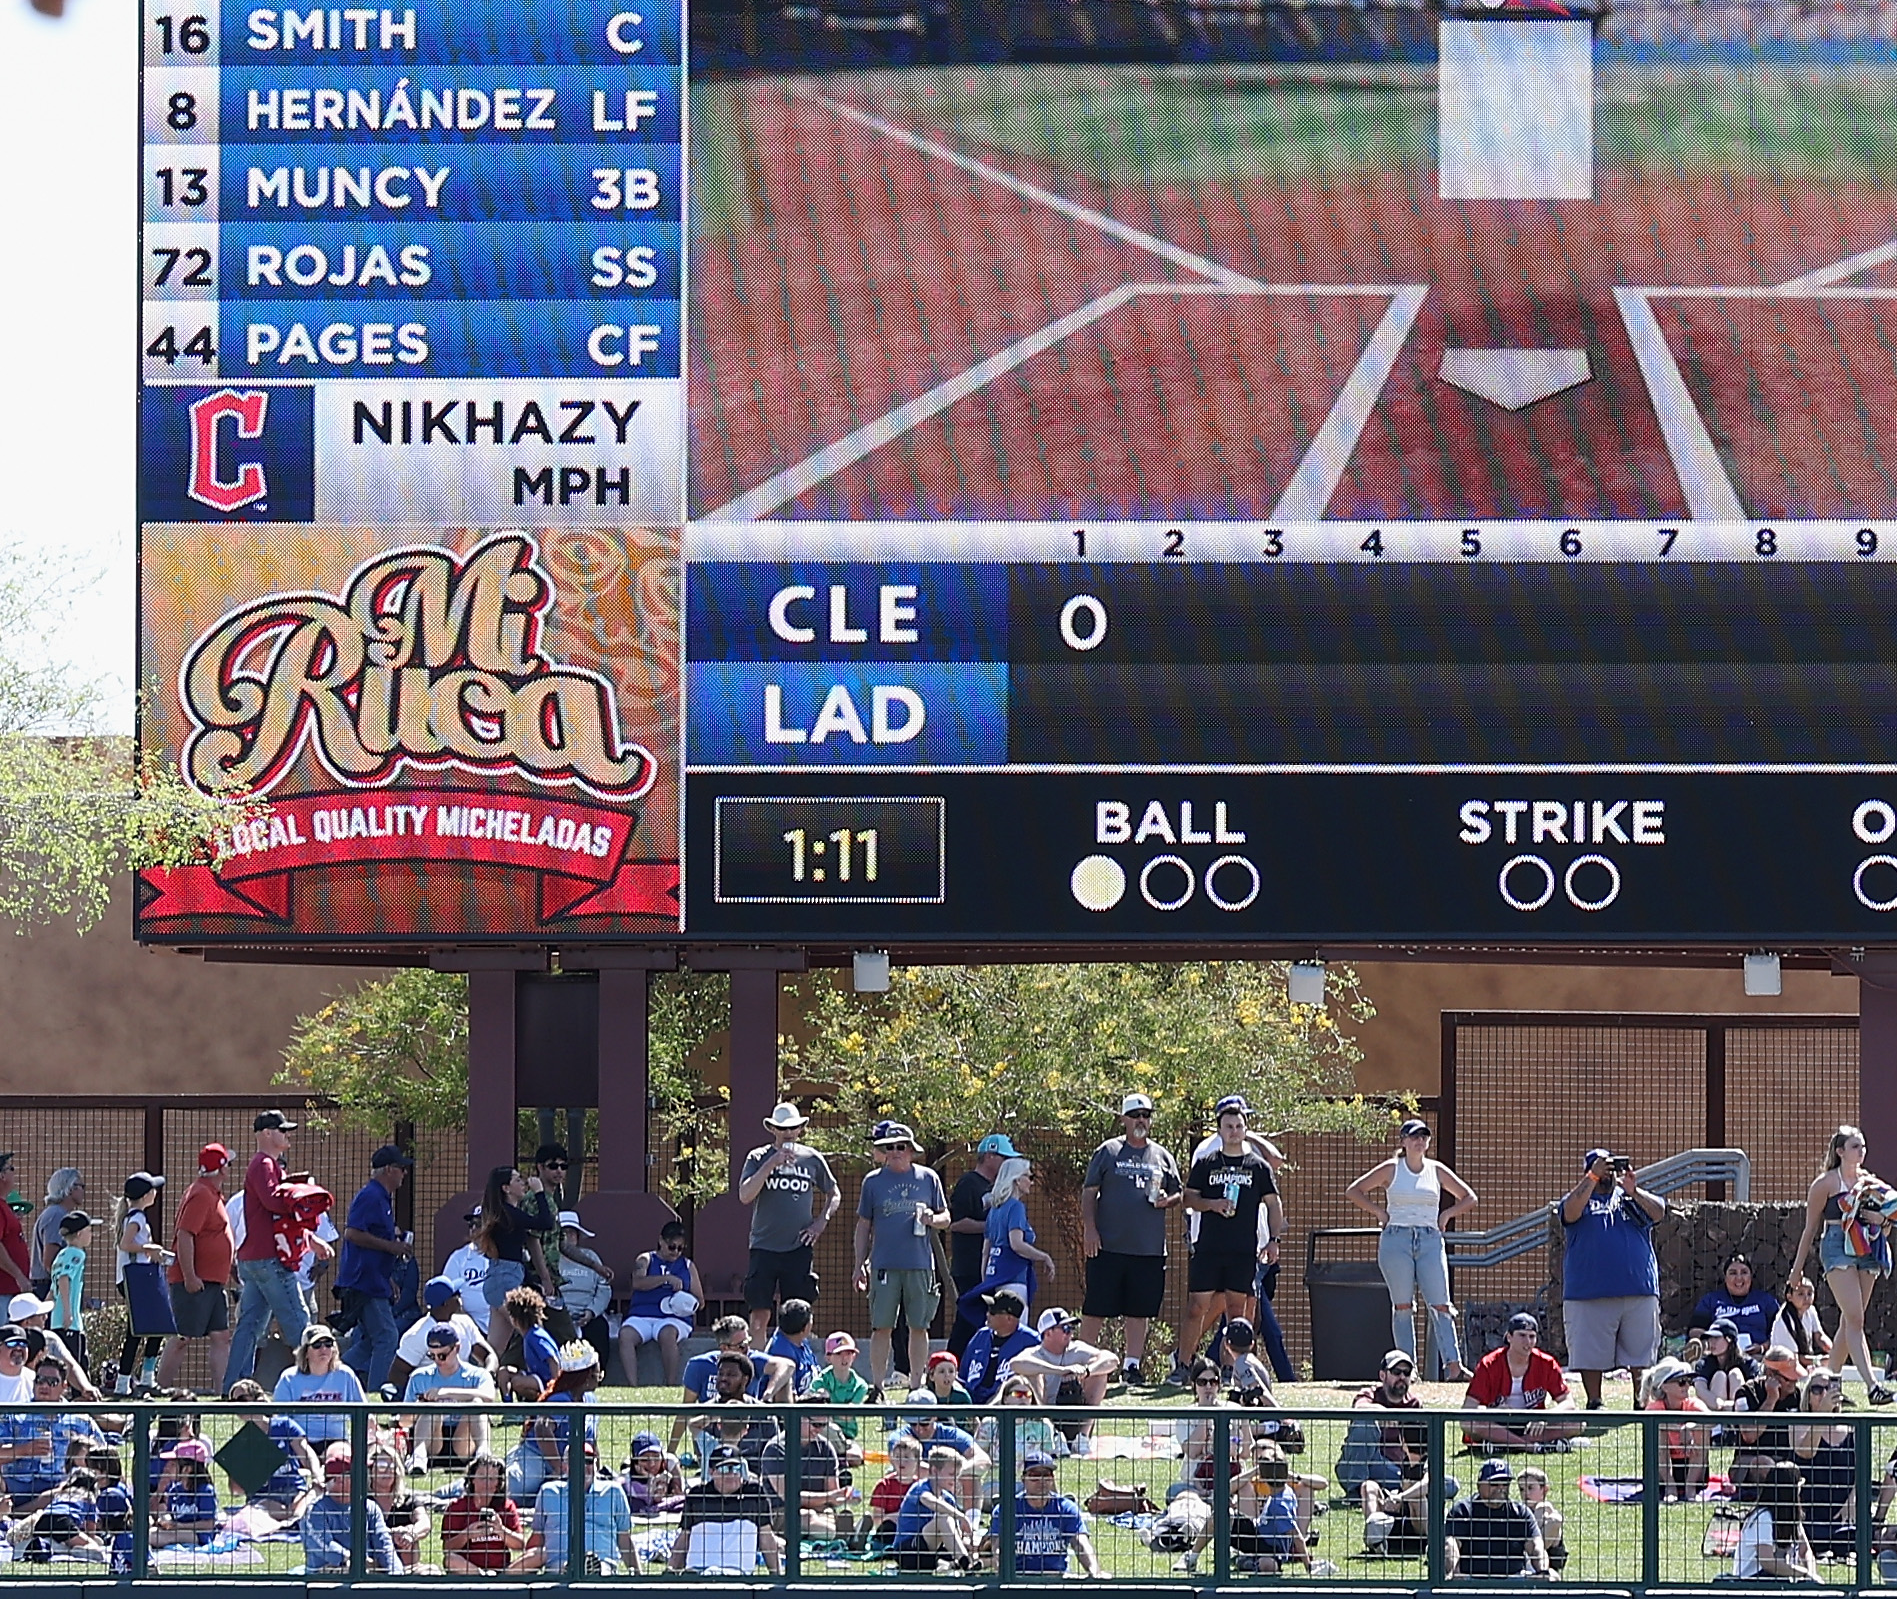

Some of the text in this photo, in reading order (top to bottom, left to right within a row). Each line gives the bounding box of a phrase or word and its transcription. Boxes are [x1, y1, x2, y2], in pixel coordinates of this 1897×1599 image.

[157, 9, 642, 55] 16 SMITH C
[167, 78, 657, 131] 8 HERNÁNDEZ LF
[157, 166, 659, 208] 13 MUNCY 3B
[154, 245, 656, 287] 72 ROJAS SS
[146, 323, 660, 365] 44 PAGES CF
[353, 401, 640, 444] NIKHAZY
[513, 467, 629, 506] MPH
[1073, 529, 1086, 557] 1
[1163, 529, 1184, 557] 2
[1264, 529, 1283, 557] 3
[1360, 529, 1384, 557] 4
[1461, 529, 1480, 557] 5
[1559, 529, 1581, 557] 6
[1658, 529, 1678, 557] 7
[1756, 529, 1777, 557] 8
[1856, 529, 1877, 557] 9
[344, 532, 555, 670] Mi
[769, 585, 917, 642] CLE
[1061, 595, 1107, 650] 0
[765, 685, 924, 742] LAD
[313, 804, 429, 843] QUALITY
[436, 805, 613, 857] MICHELADAS
[1097, 801, 1245, 843] BALL
[1460, 801, 1664, 843] STRIKE
[784, 829, 877, 880] 1:11
[765, 1177, 809, 1192] WOOD
[1209, 1172, 1253, 1186] CHAMPIONS
